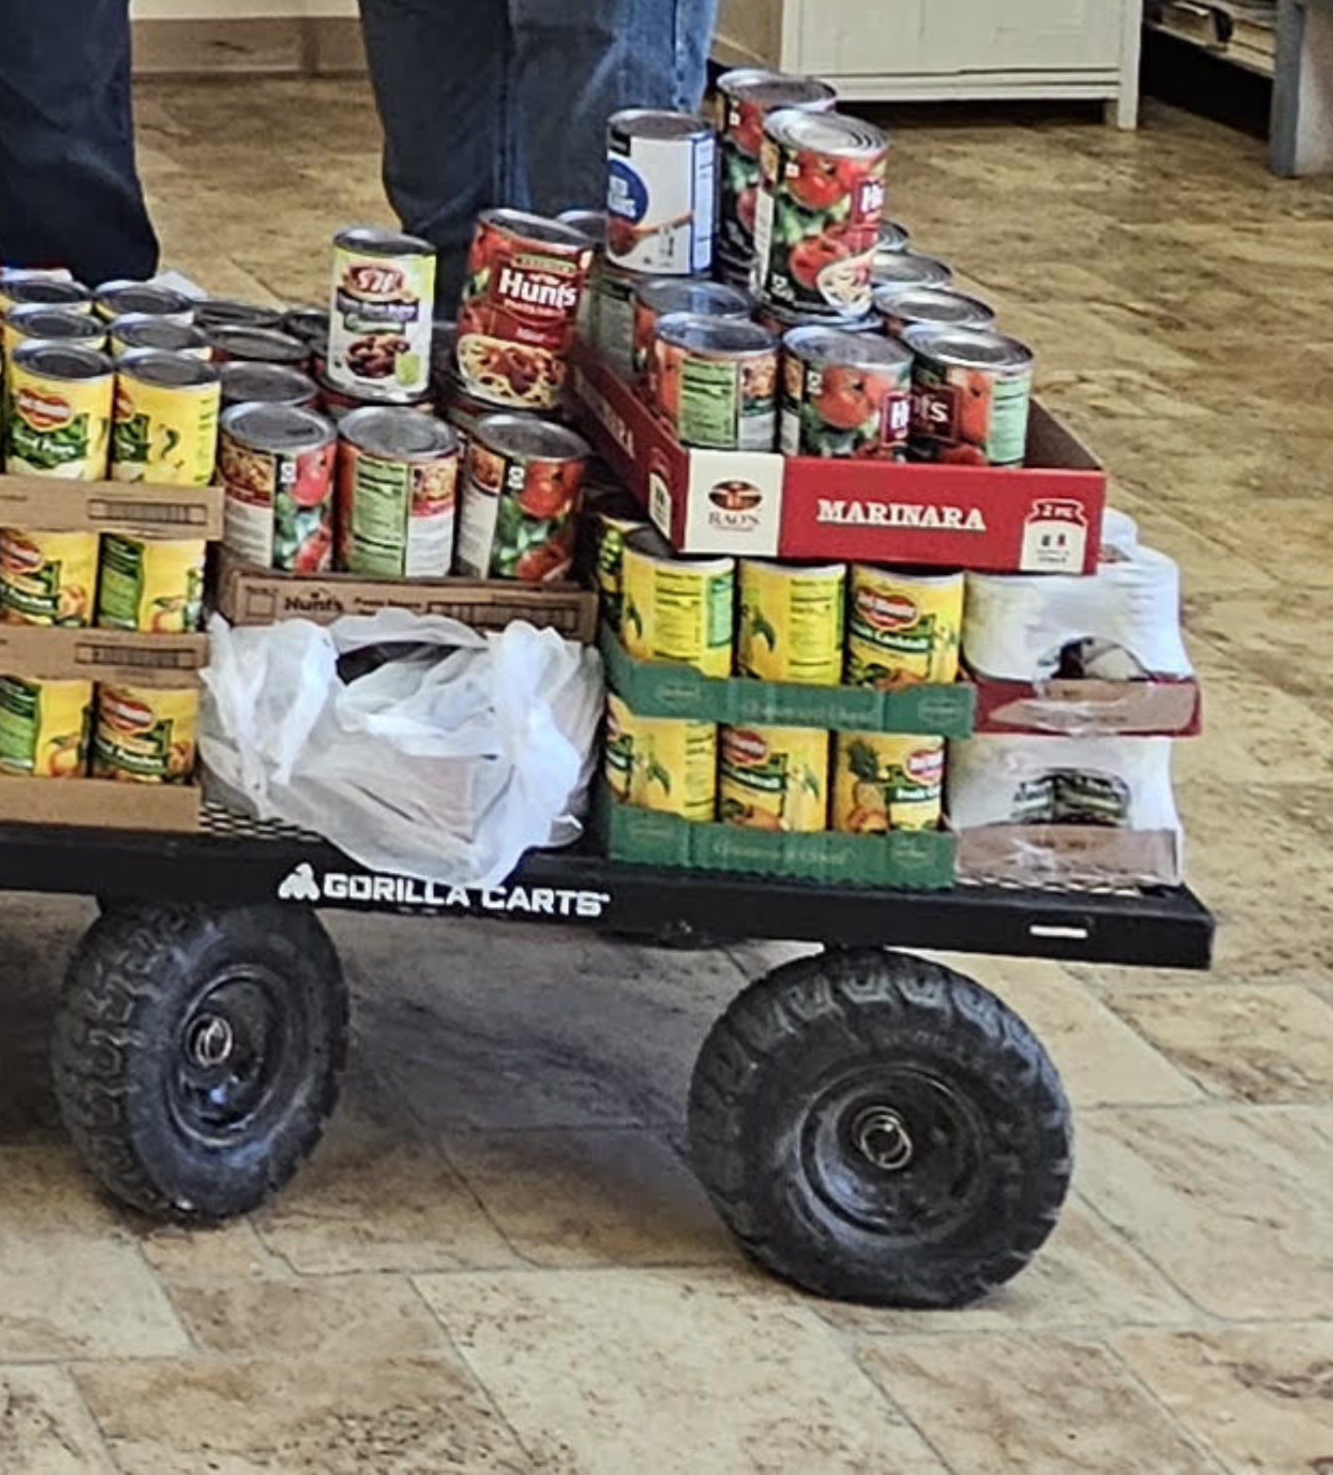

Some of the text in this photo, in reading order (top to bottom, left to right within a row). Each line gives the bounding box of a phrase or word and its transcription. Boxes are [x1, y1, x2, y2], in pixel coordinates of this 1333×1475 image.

[498, 267, 578, 309] Hunt's
[816, 498, 987, 532] MARINARA
[323, 872, 604, 917] GORILLA CARTS
